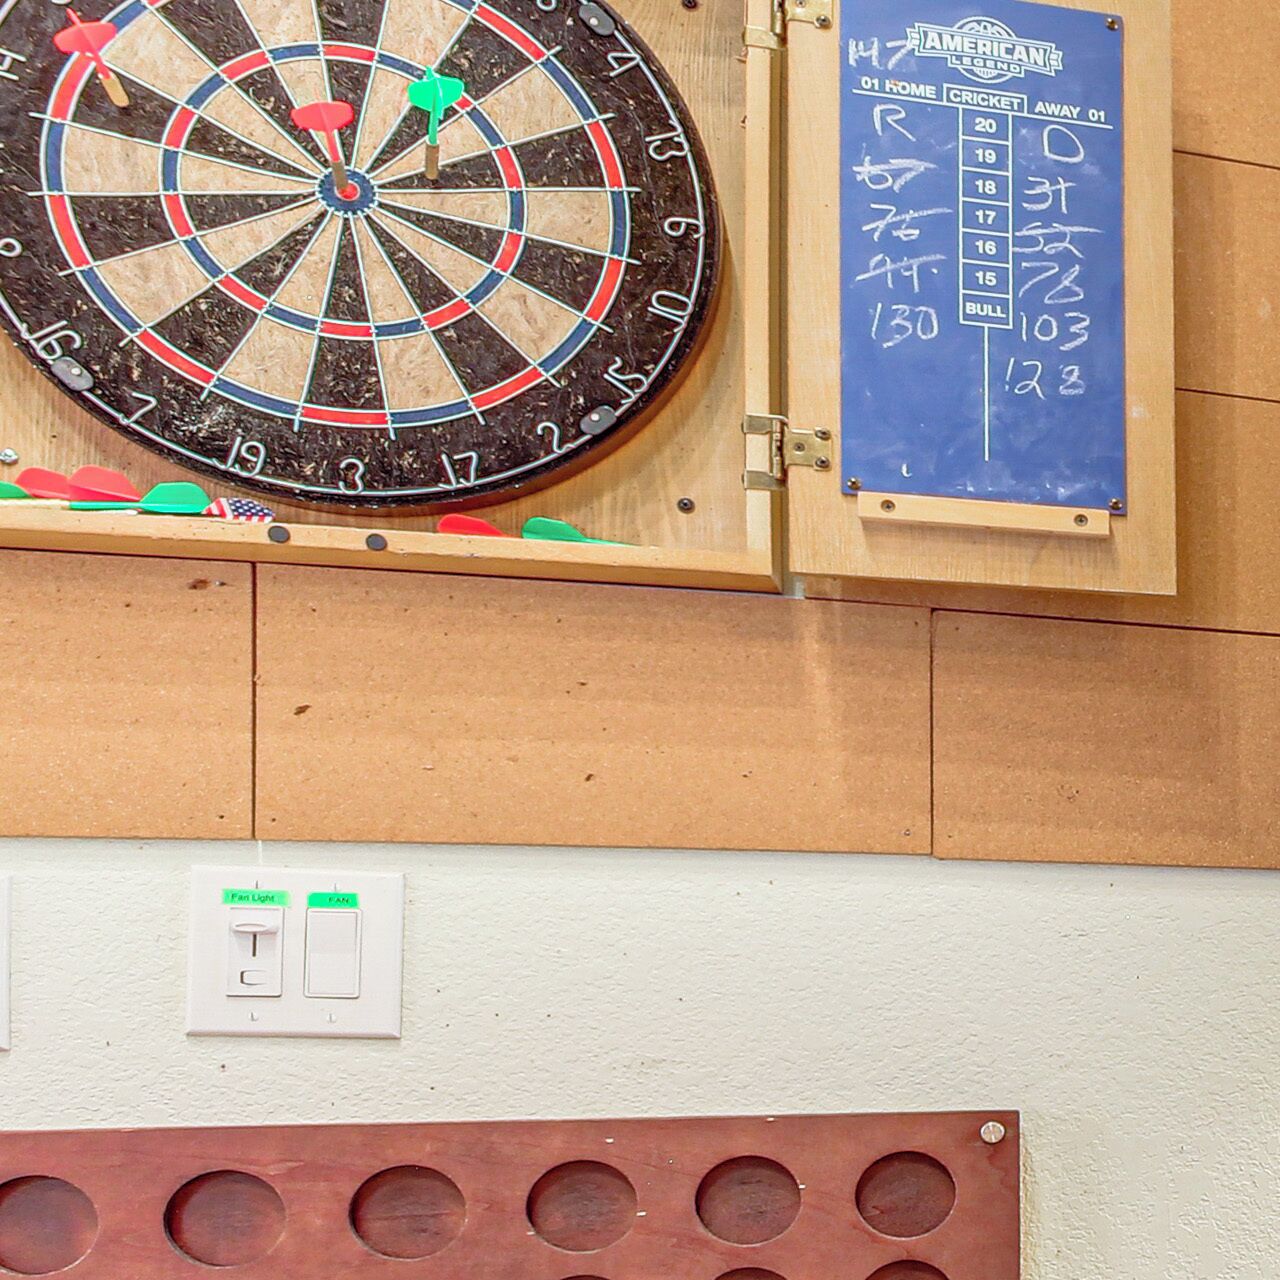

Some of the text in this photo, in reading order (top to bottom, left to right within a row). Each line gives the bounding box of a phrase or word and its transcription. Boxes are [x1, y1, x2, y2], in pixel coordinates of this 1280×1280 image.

[924, 29, 1046, 67] AMERICAN
[950, 56, 1022, 74] LEGEND
[861, 76, 937, 99] 01 HOME
[949, 89, 1022, 110] CRICKET
[1034, 101, 1106, 122] AWAY 01
[871, 103, 917, 142] R
[974, 117, 997, 134] 20
[974, 148, 997, 165] 19
[974, 179, 997, 196] 18
[974, 210, 997, 226] 17
[974, 240, 997, 256] 16
[974, 271, 997, 287] 15
[964, 301, 1007, 319] BULL
[1019, 311, 1091, 351] 103
[212, 436, 267, 477] 19
[338, 457, 365, 495] 3
[438, 451, 480, 490] 17
[230, 892, 275, 903] Fan Light
[328, 896, 350, 904] FAN
